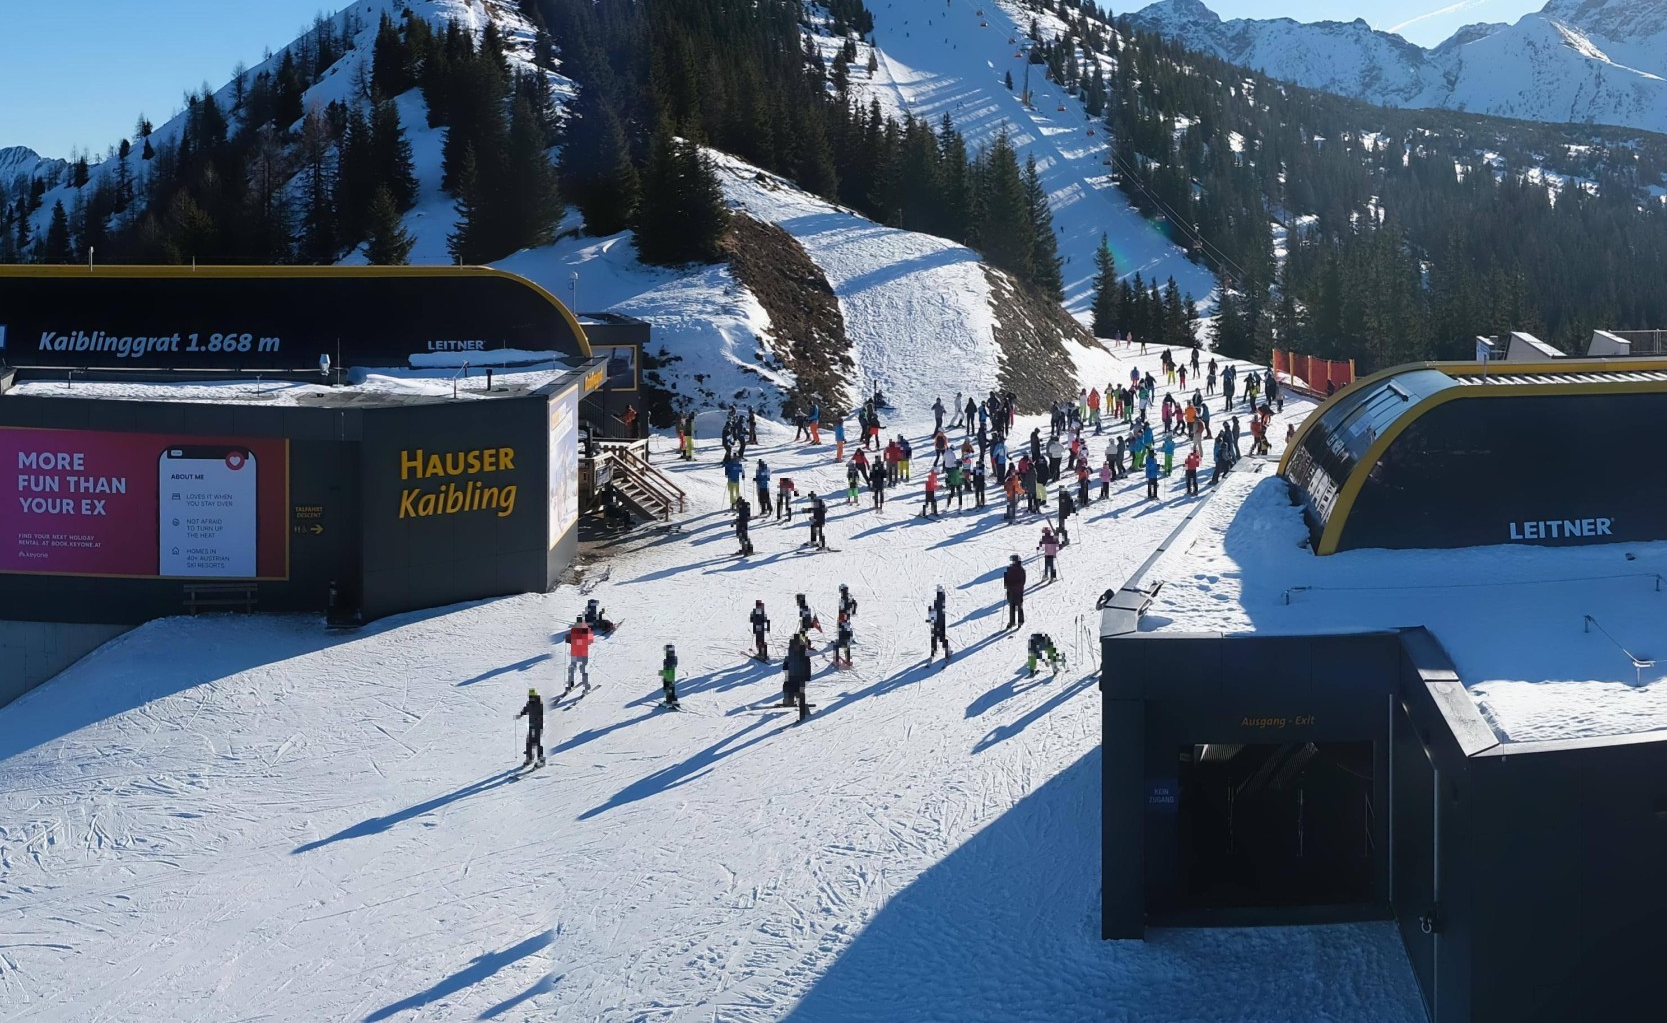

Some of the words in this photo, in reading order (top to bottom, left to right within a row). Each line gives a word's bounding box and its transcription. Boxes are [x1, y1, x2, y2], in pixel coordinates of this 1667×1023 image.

[38, 331, 180, 358] Kaiblinggrat
[185, 333, 252, 352] 1.868
[257, 336, 280, 352] m
[427, 340, 485, 351] LEITNER
[18, 451, 85, 471] MORE
[400, 447, 516, 480] HAUSER
[18, 475, 59, 492] FUN
[66, 476, 126, 494] THAN
[19, 497, 75, 515] YOUR
[81, 499, 107, 515] EX
[398, 481, 518, 519] Kaibling
[1509, 517, 1613, 540] LEITNER
[26, 551, 49, 559] keyone
[1241, 717, 1287, 728] Ausgang
[1295, 715, 1316, 726] Exit
[1149, 796, 1175, 804] ZUGANG
